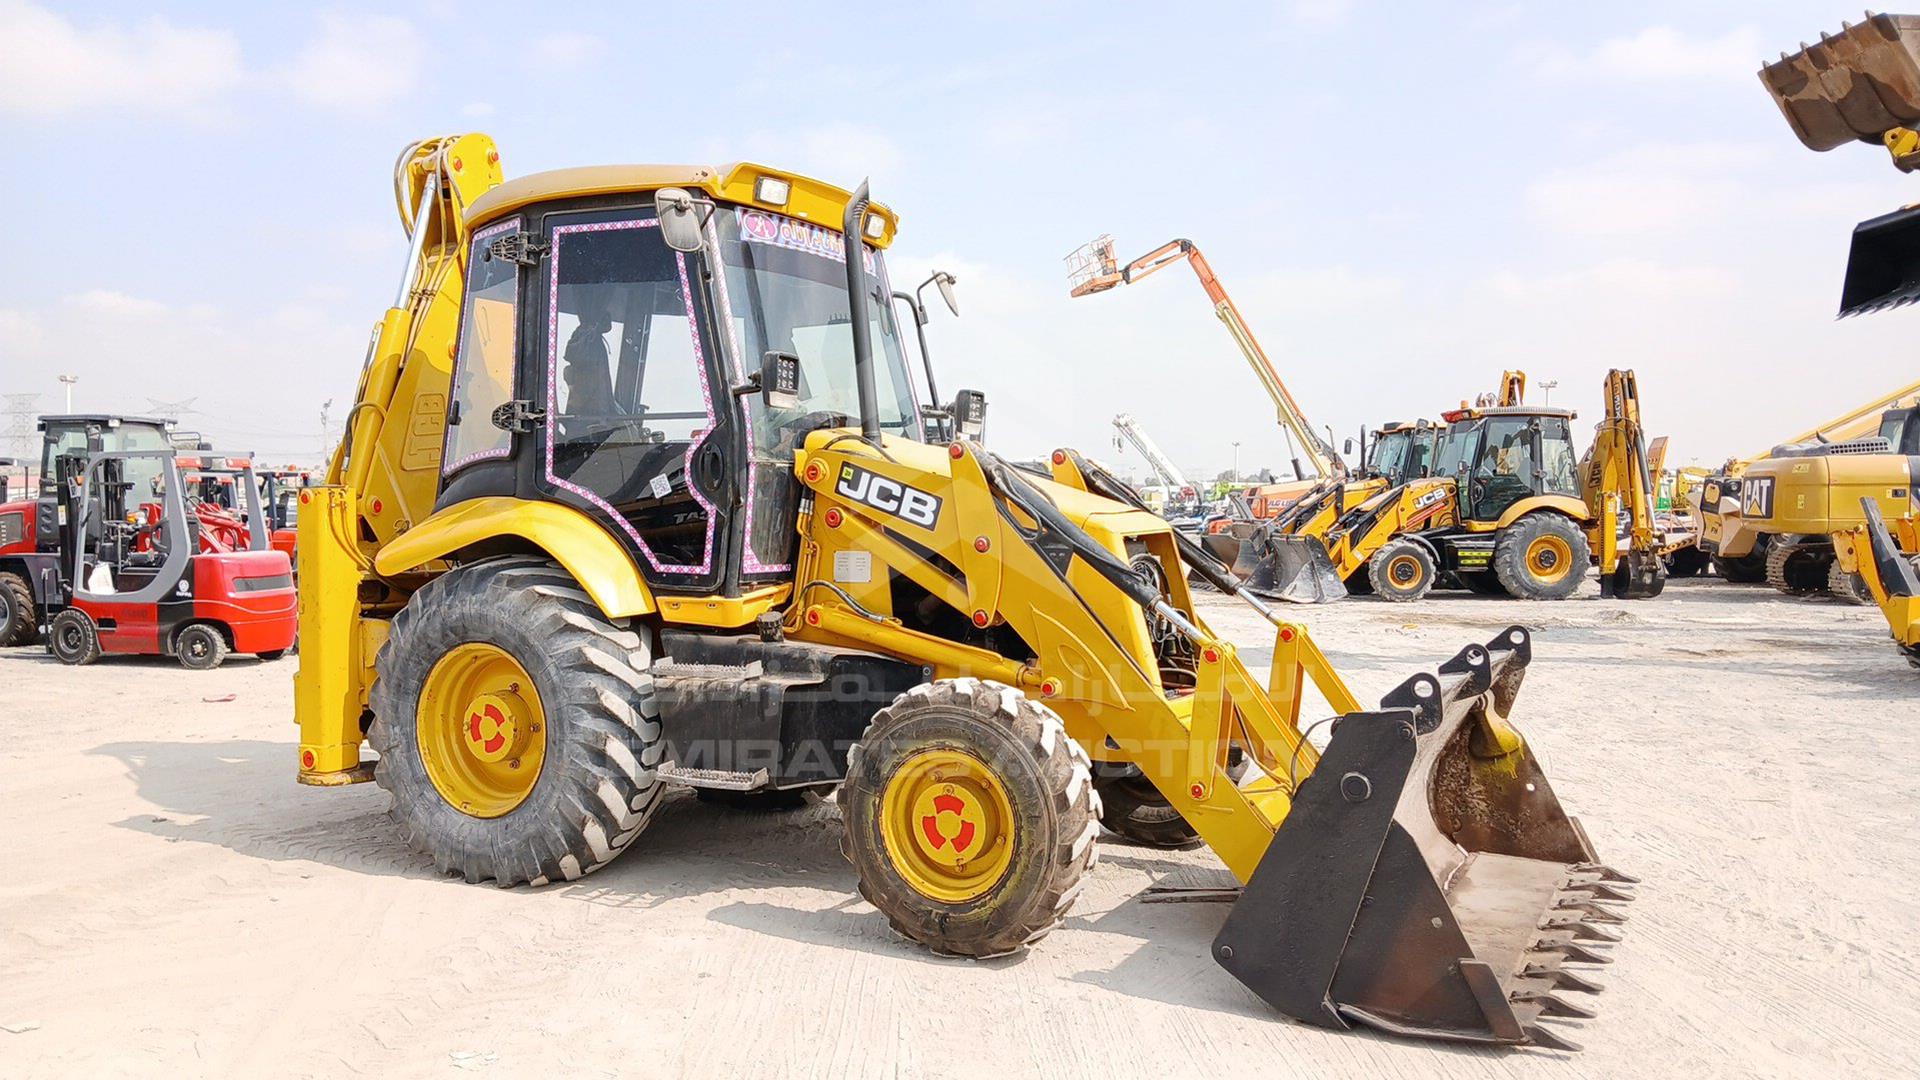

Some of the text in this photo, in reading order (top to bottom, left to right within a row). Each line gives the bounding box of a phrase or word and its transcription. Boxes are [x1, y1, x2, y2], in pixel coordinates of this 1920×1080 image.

[838, 472, 938, 526] JCB
[1415, 488, 1446, 508] JCB
[1743, 479, 1771, 516] CAT
